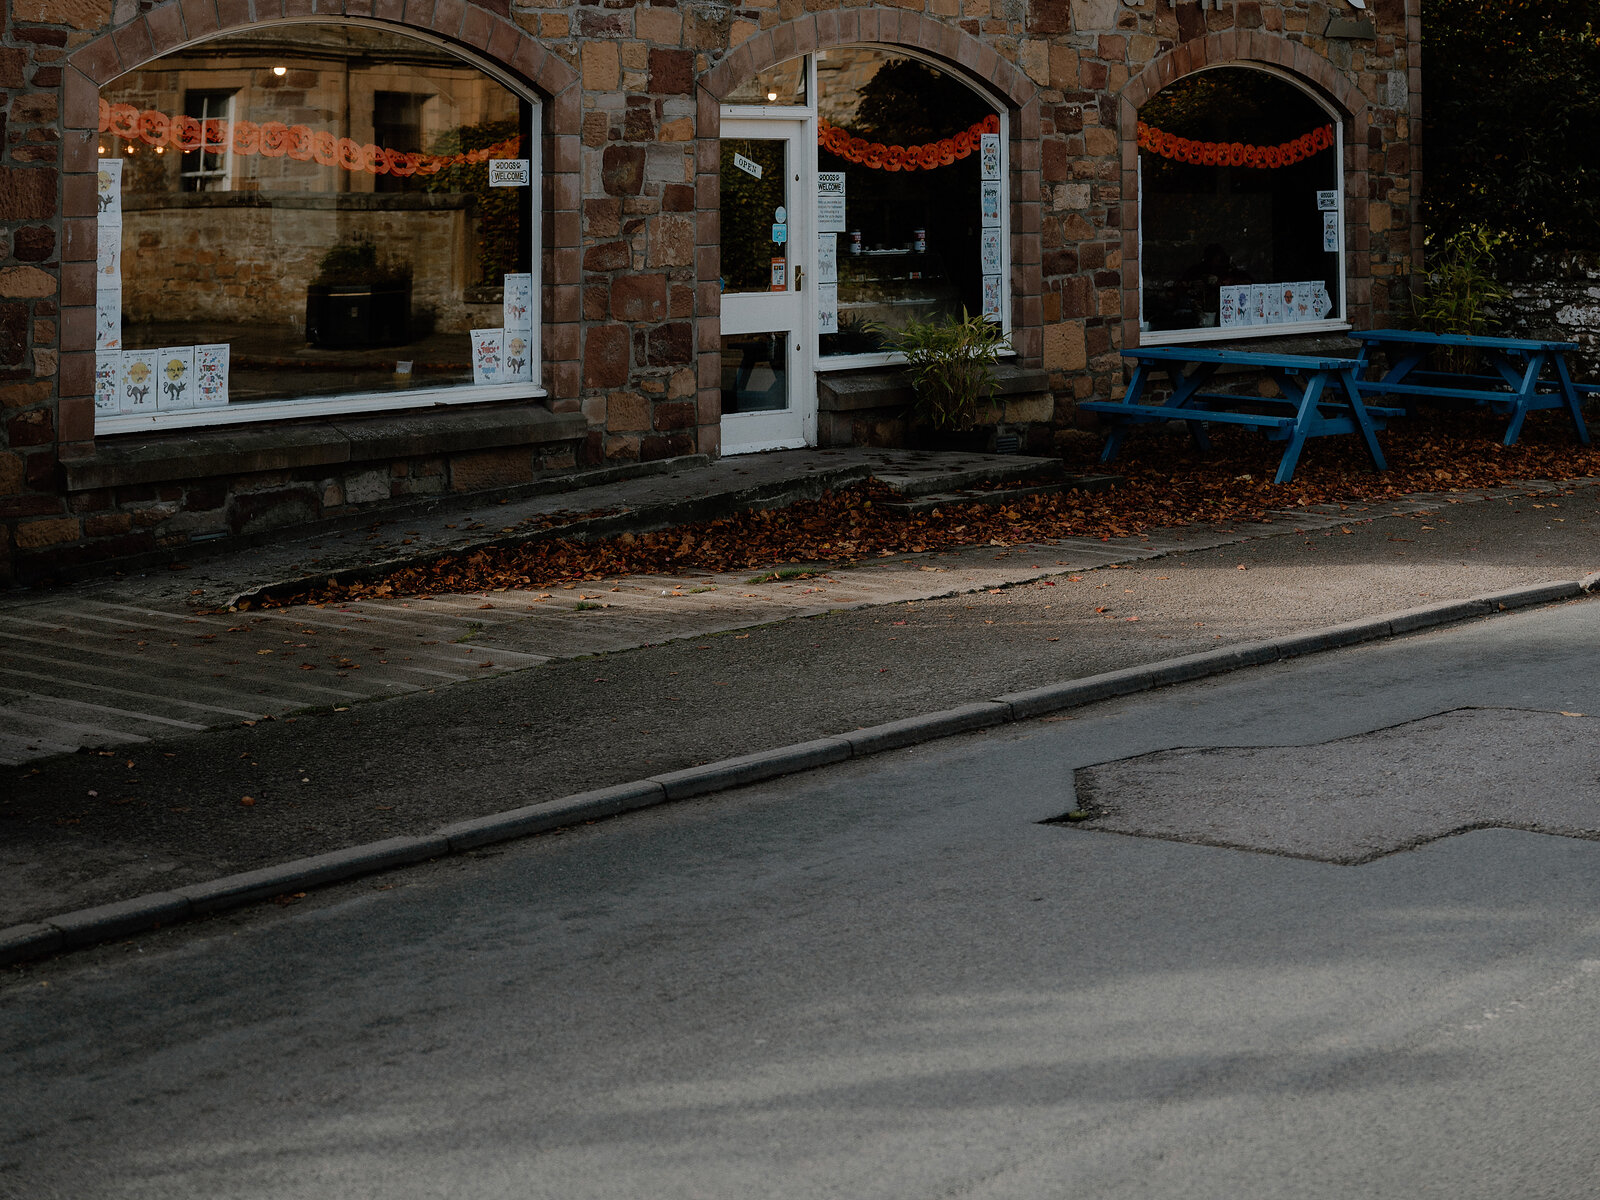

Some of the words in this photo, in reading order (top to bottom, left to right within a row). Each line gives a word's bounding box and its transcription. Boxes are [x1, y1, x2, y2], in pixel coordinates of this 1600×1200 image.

[500, 162, 516, 170] DOGS
[738, 158, 757, 174] OPEN
[494, 172, 524, 180] WELCOME
[822, 174, 836, 182] DOGS
[818, 183, 842, 191] WELCOME
